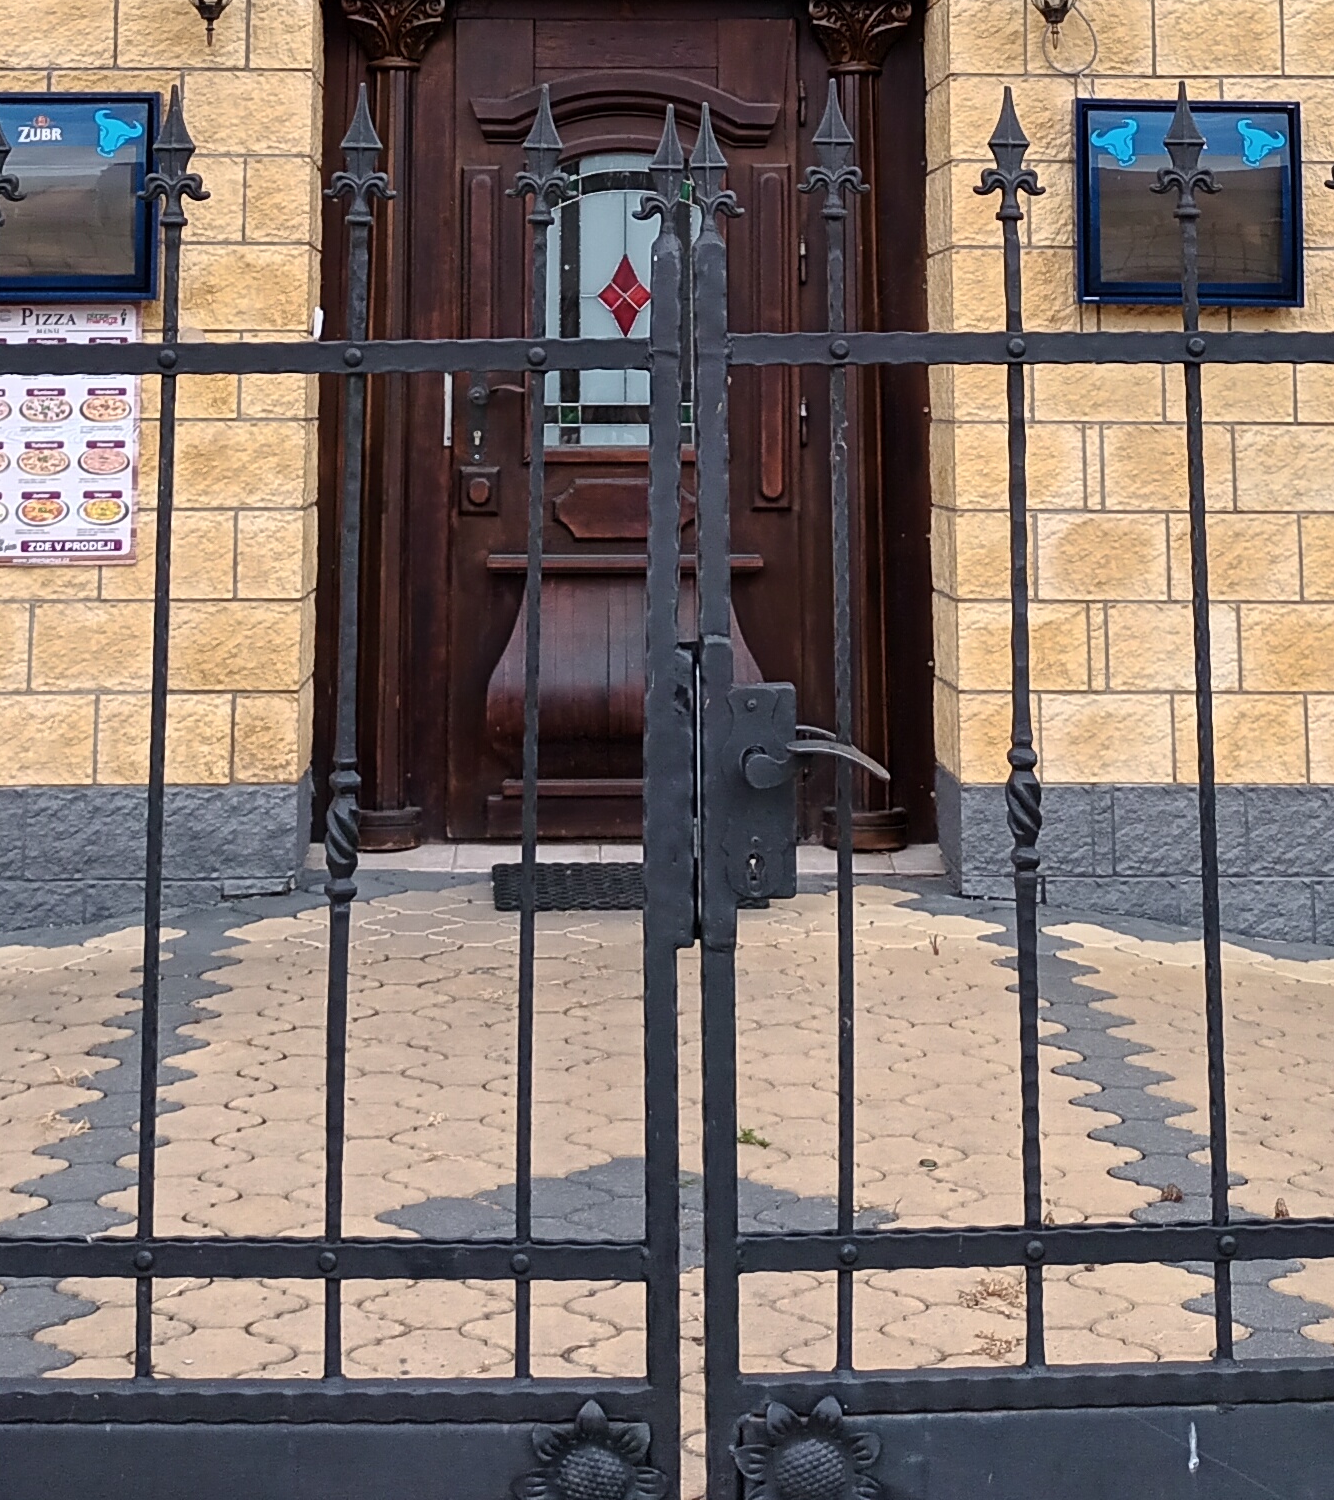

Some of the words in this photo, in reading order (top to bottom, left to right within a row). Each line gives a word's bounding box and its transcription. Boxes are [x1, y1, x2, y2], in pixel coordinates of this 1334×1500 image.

[17, 126, 63, 143] ZUBR
[20, 307, 77, 326] PIZZA
[27, 542, 53, 552] ZDE
[54, 541, 64, 551] V
